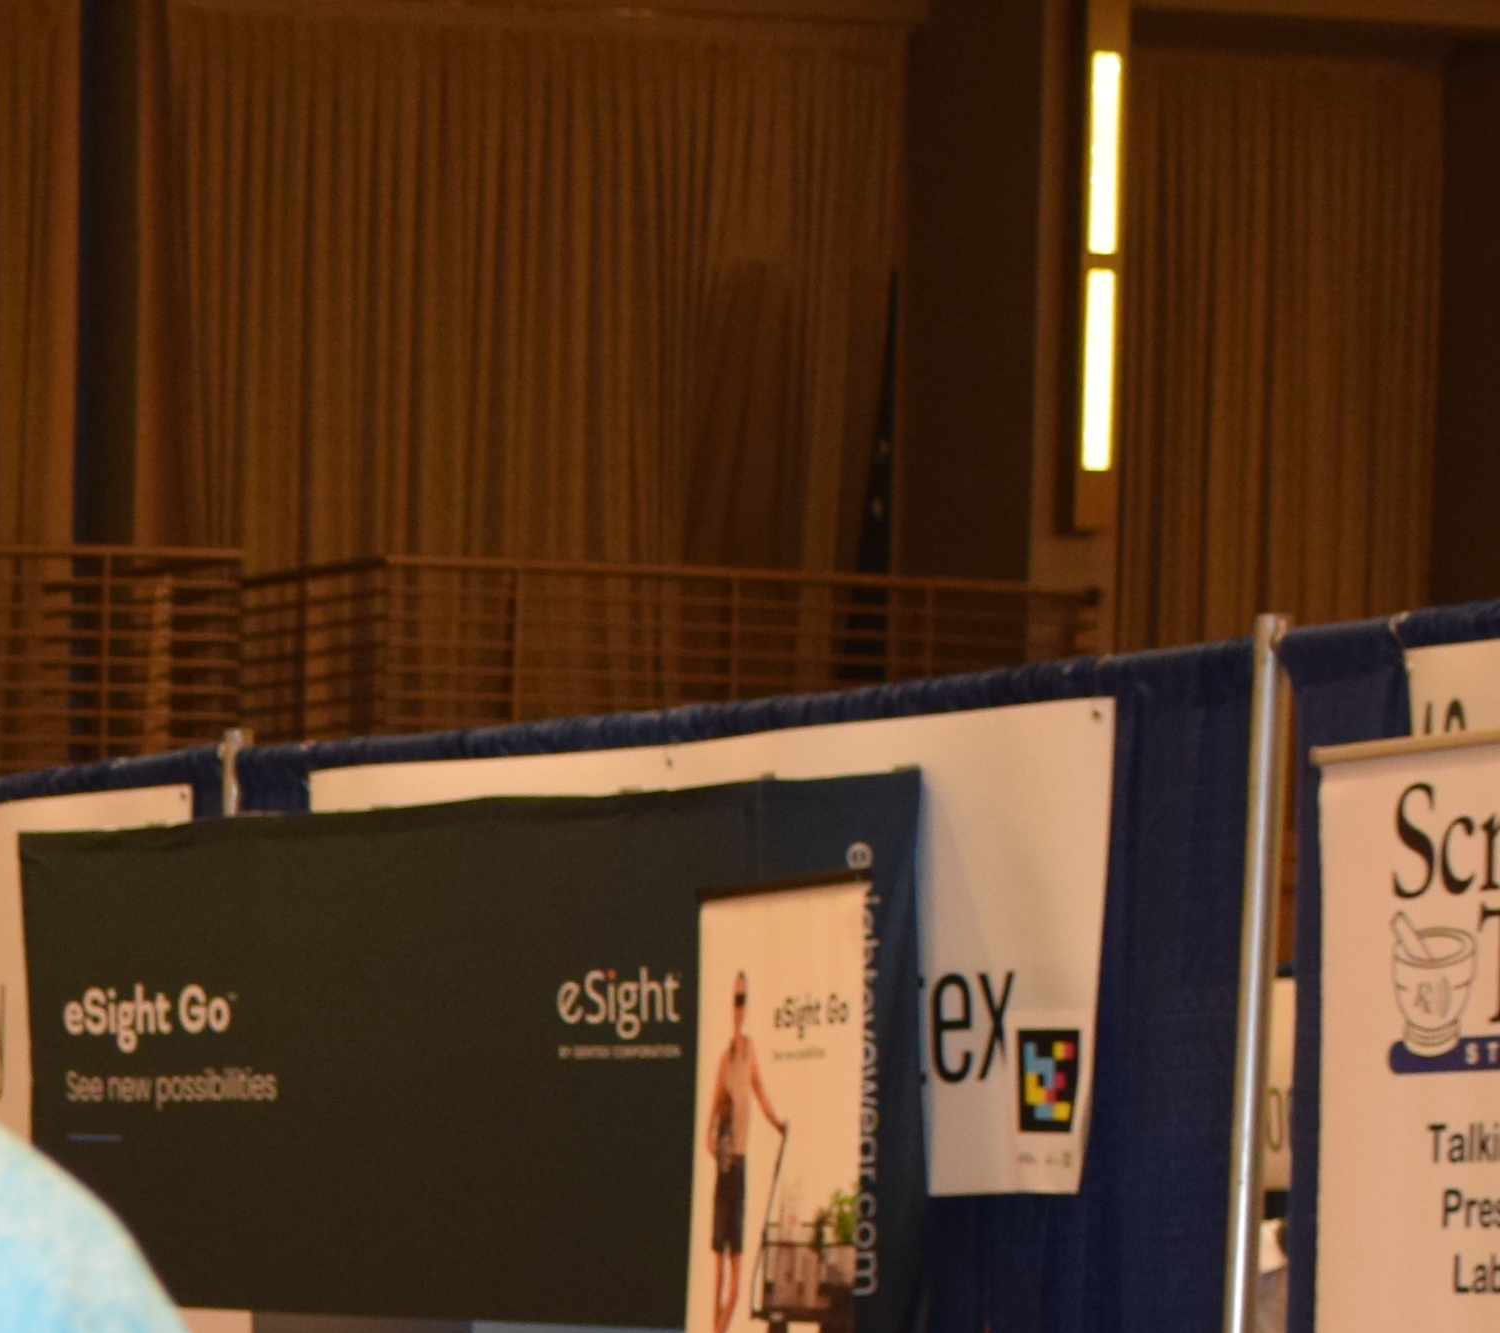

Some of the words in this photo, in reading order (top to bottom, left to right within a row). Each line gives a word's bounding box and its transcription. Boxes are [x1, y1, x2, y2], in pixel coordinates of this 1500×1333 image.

[63, 982, 173, 1053] eSight
[557, 966, 681, 1040] eSight
[774, 993, 821, 1040] eSight
[826, 992, 850, 1024] Go
[66, 1070, 105, 1101] See
[107, 1076, 152, 1102] new
[155, 1066, 278, 1112] possibilities
